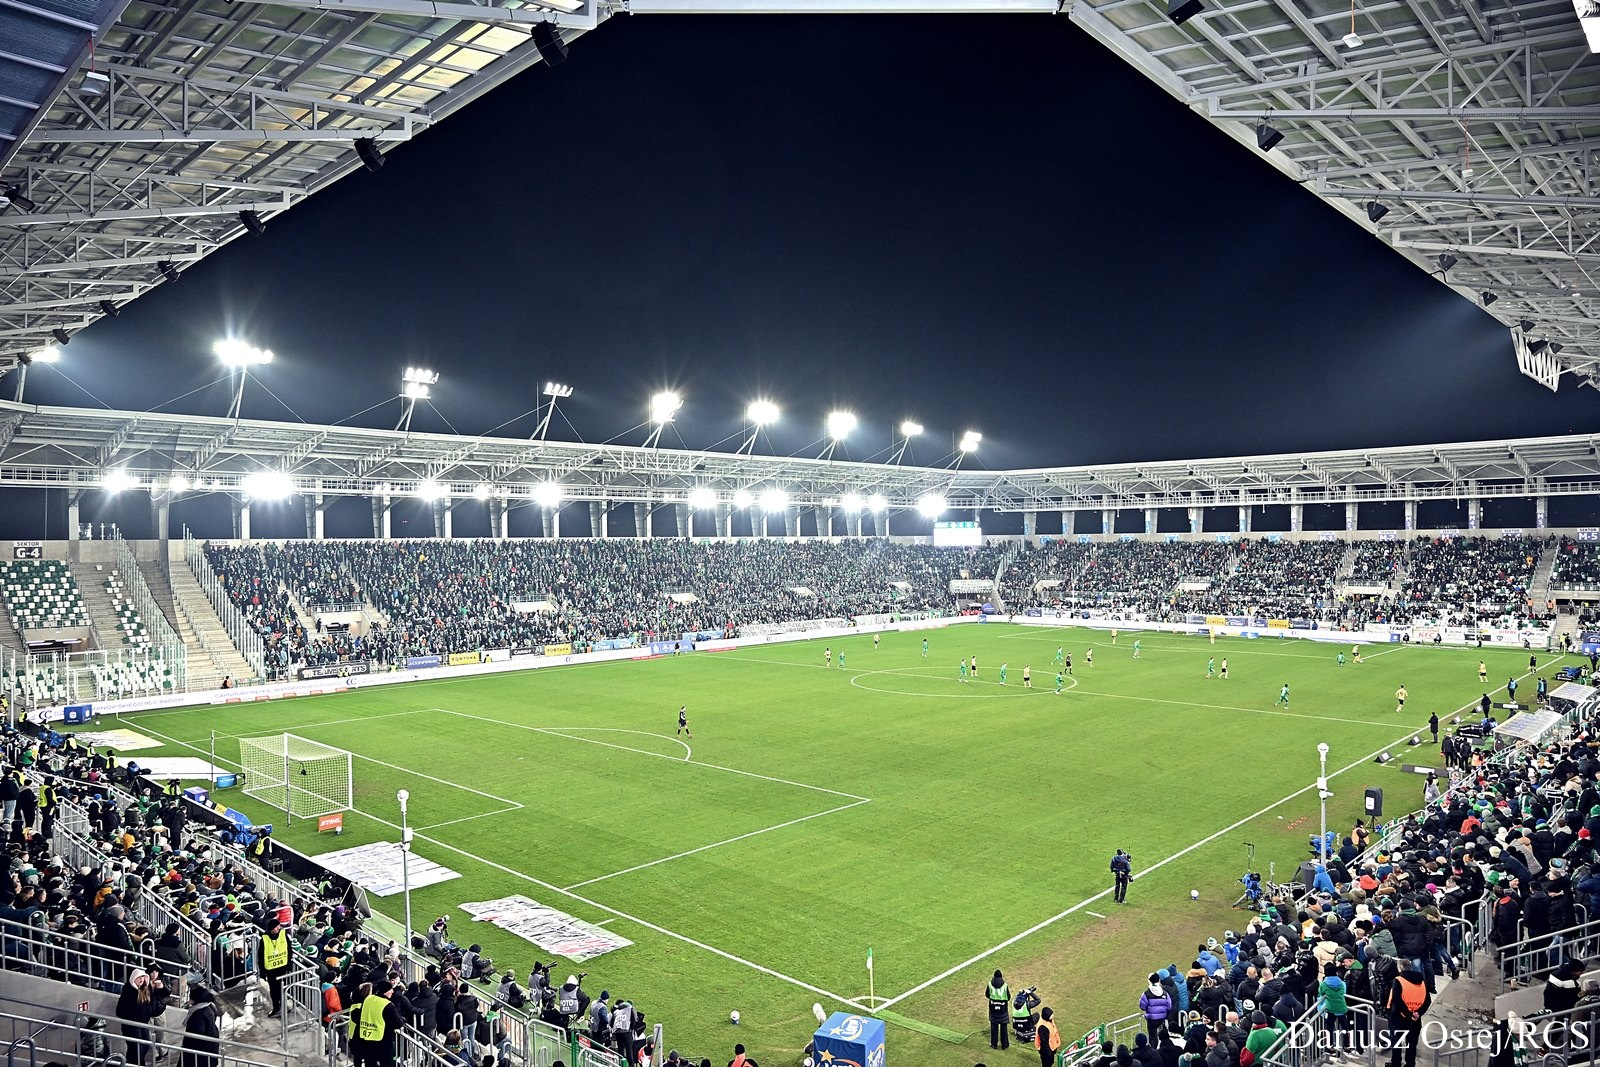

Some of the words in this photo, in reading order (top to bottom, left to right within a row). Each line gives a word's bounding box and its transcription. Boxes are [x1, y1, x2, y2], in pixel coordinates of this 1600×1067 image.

[1579, 532, 1598, 540] M-5
[16, 548, 40, 558] G-4
[320, 818, 341, 826] STIHL
